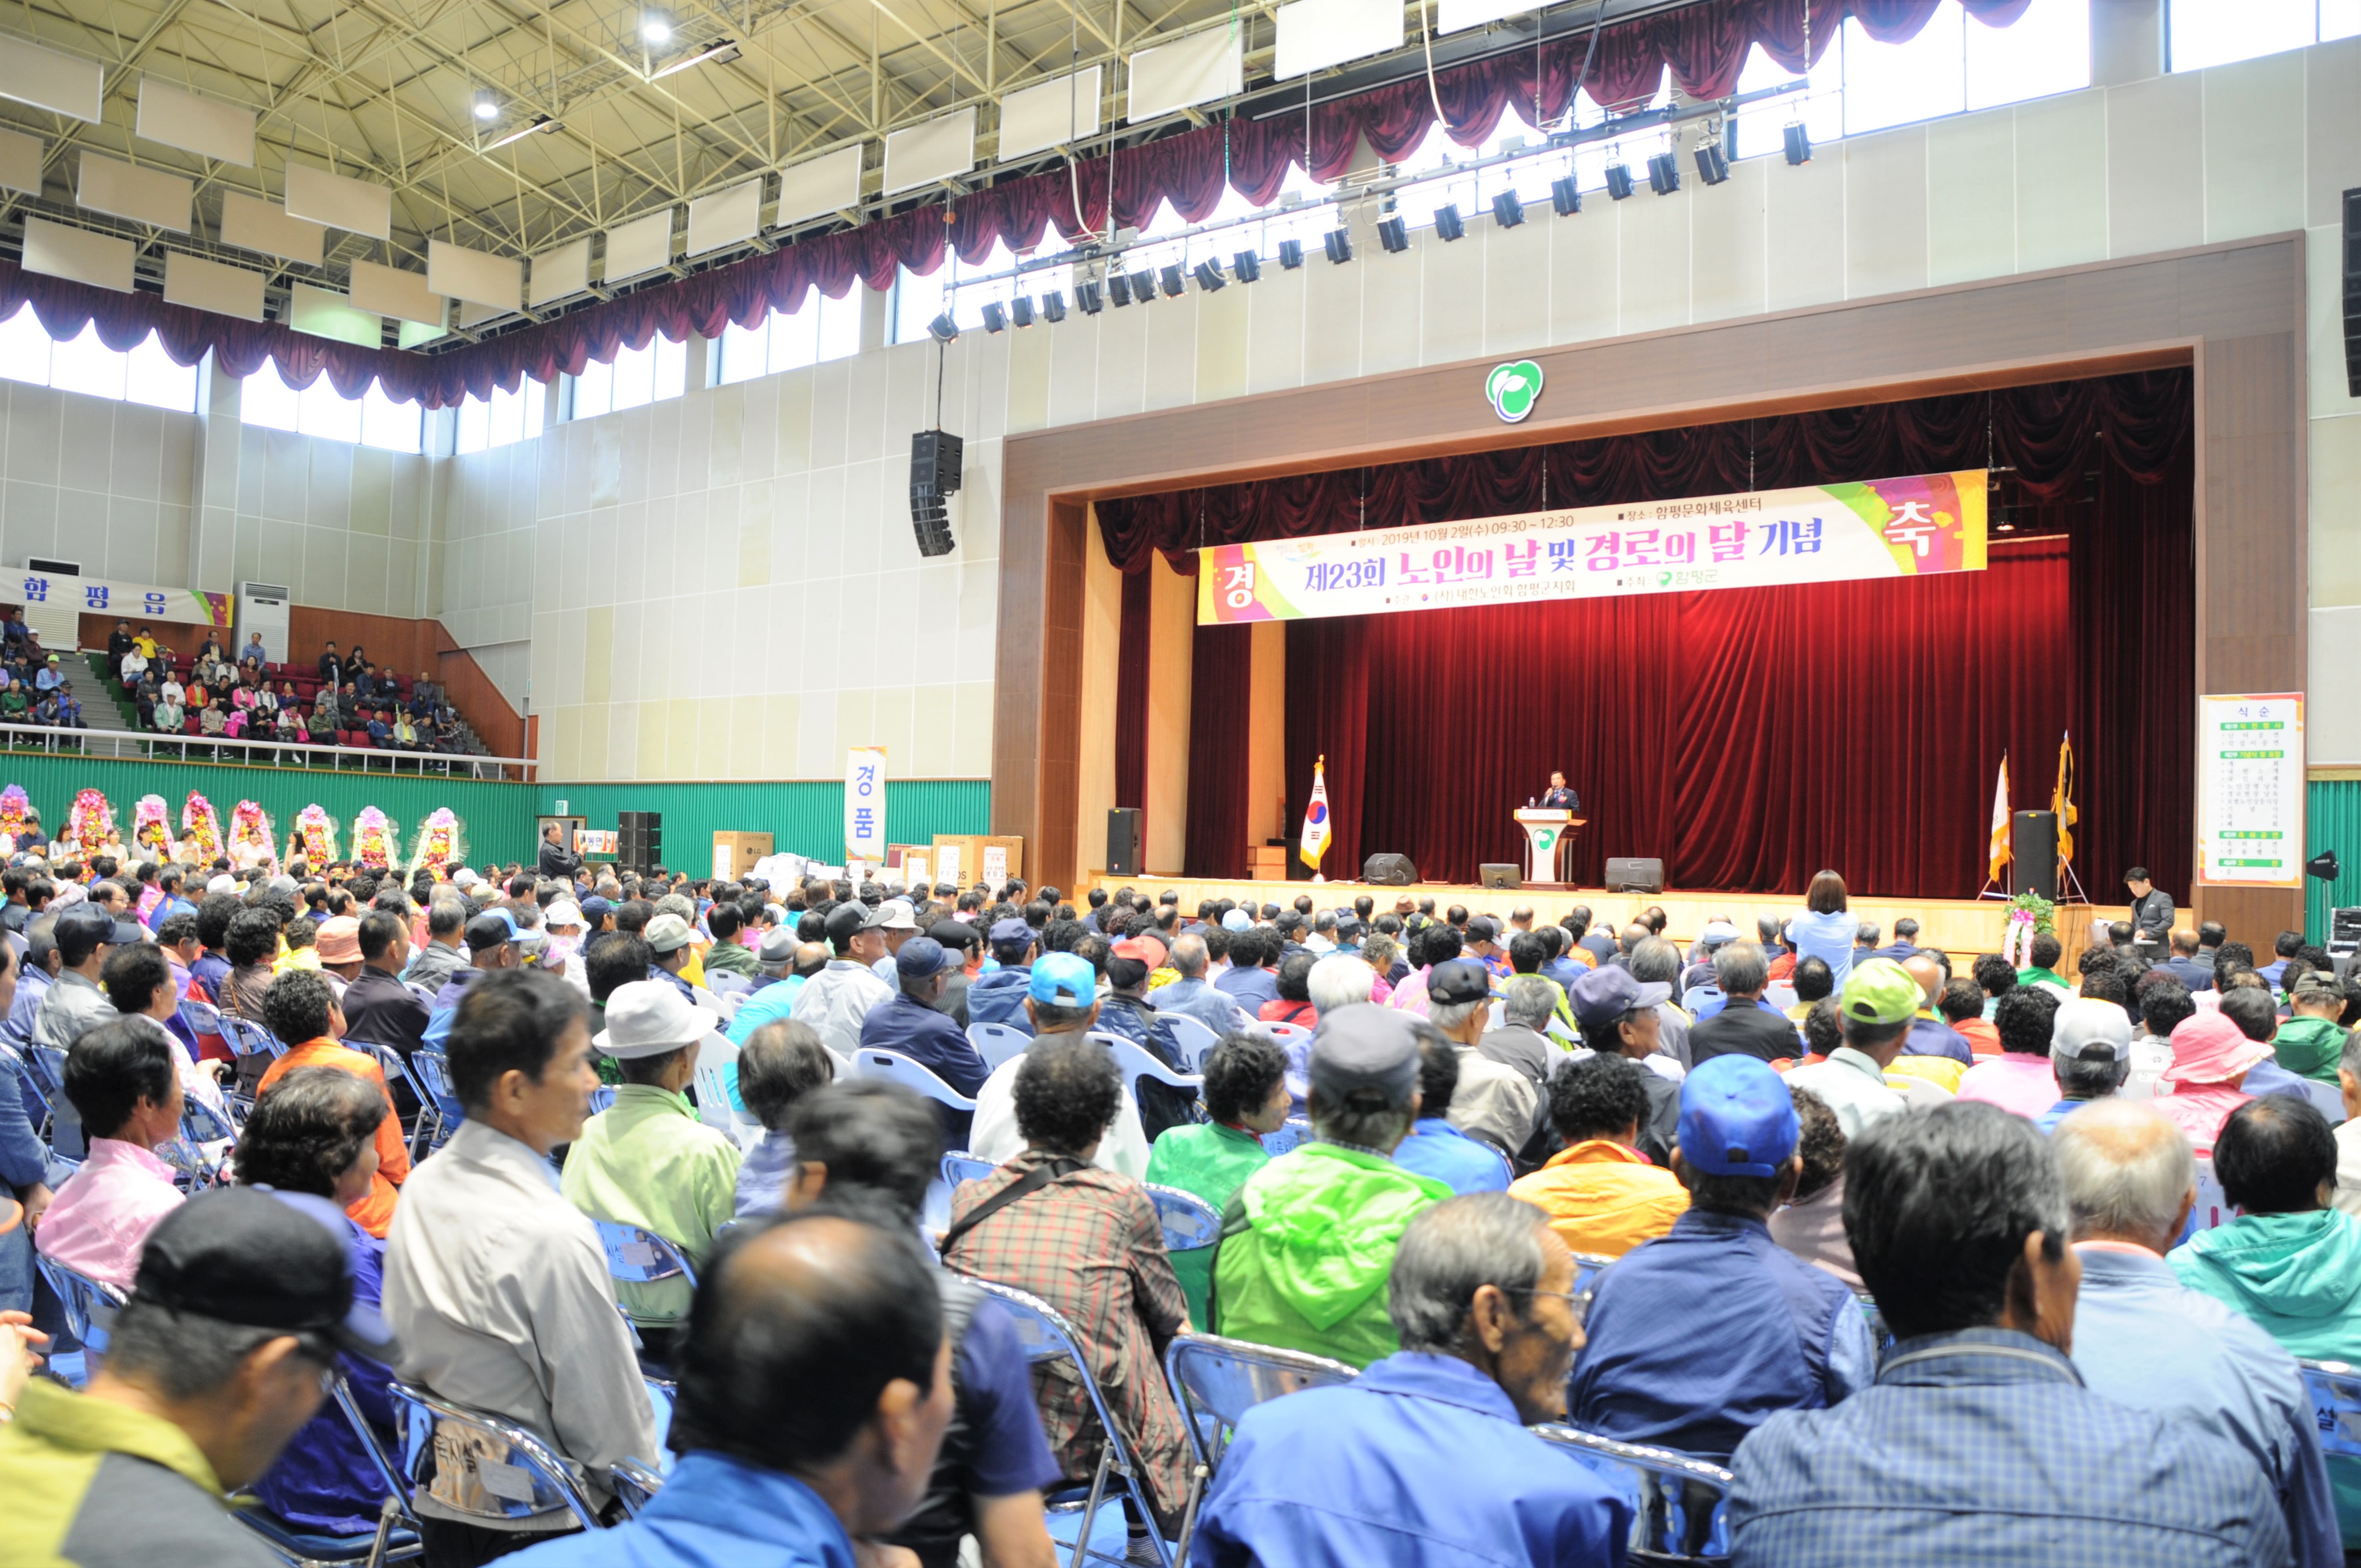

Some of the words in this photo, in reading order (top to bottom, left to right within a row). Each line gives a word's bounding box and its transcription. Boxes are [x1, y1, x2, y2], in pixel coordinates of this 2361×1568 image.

[1627, 509, 1646, 522] 장소
[1656, 498, 1762, 521] 함평문화체육센터
[1884, 501, 1936, 557] 축
[1359, 537, 1375, 547] 일시
[1381, 532, 1419, 546] 2019년
[1424, 528, 1448, 541] 10월
[1451, 523, 1488, 538] 2일(수)
[1491, 520, 1527, 534] 09:30
[1541, 515, 1574, 529] 12:30
[1304, 557, 1386, 592] 제23회
[1397, 546, 1494, 586] 노인의
[1504, 538, 1542, 578] 날
[1548, 538, 1575, 573] 및
[1584, 528, 1696, 572] 경로의
[1708, 521, 1751, 562] 달
[1758, 517, 1823, 556] 기념
[1225, 561, 1255, 608] 경
[1435, 589, 1454, 603] (사)
[1457, 584, 1514, 600] 대한노인회
[1517, 580, 1575, 596] 함평군지회
[1675, 569, 1718, 585] 함평군
[854, 764, 875, 839] 경품
